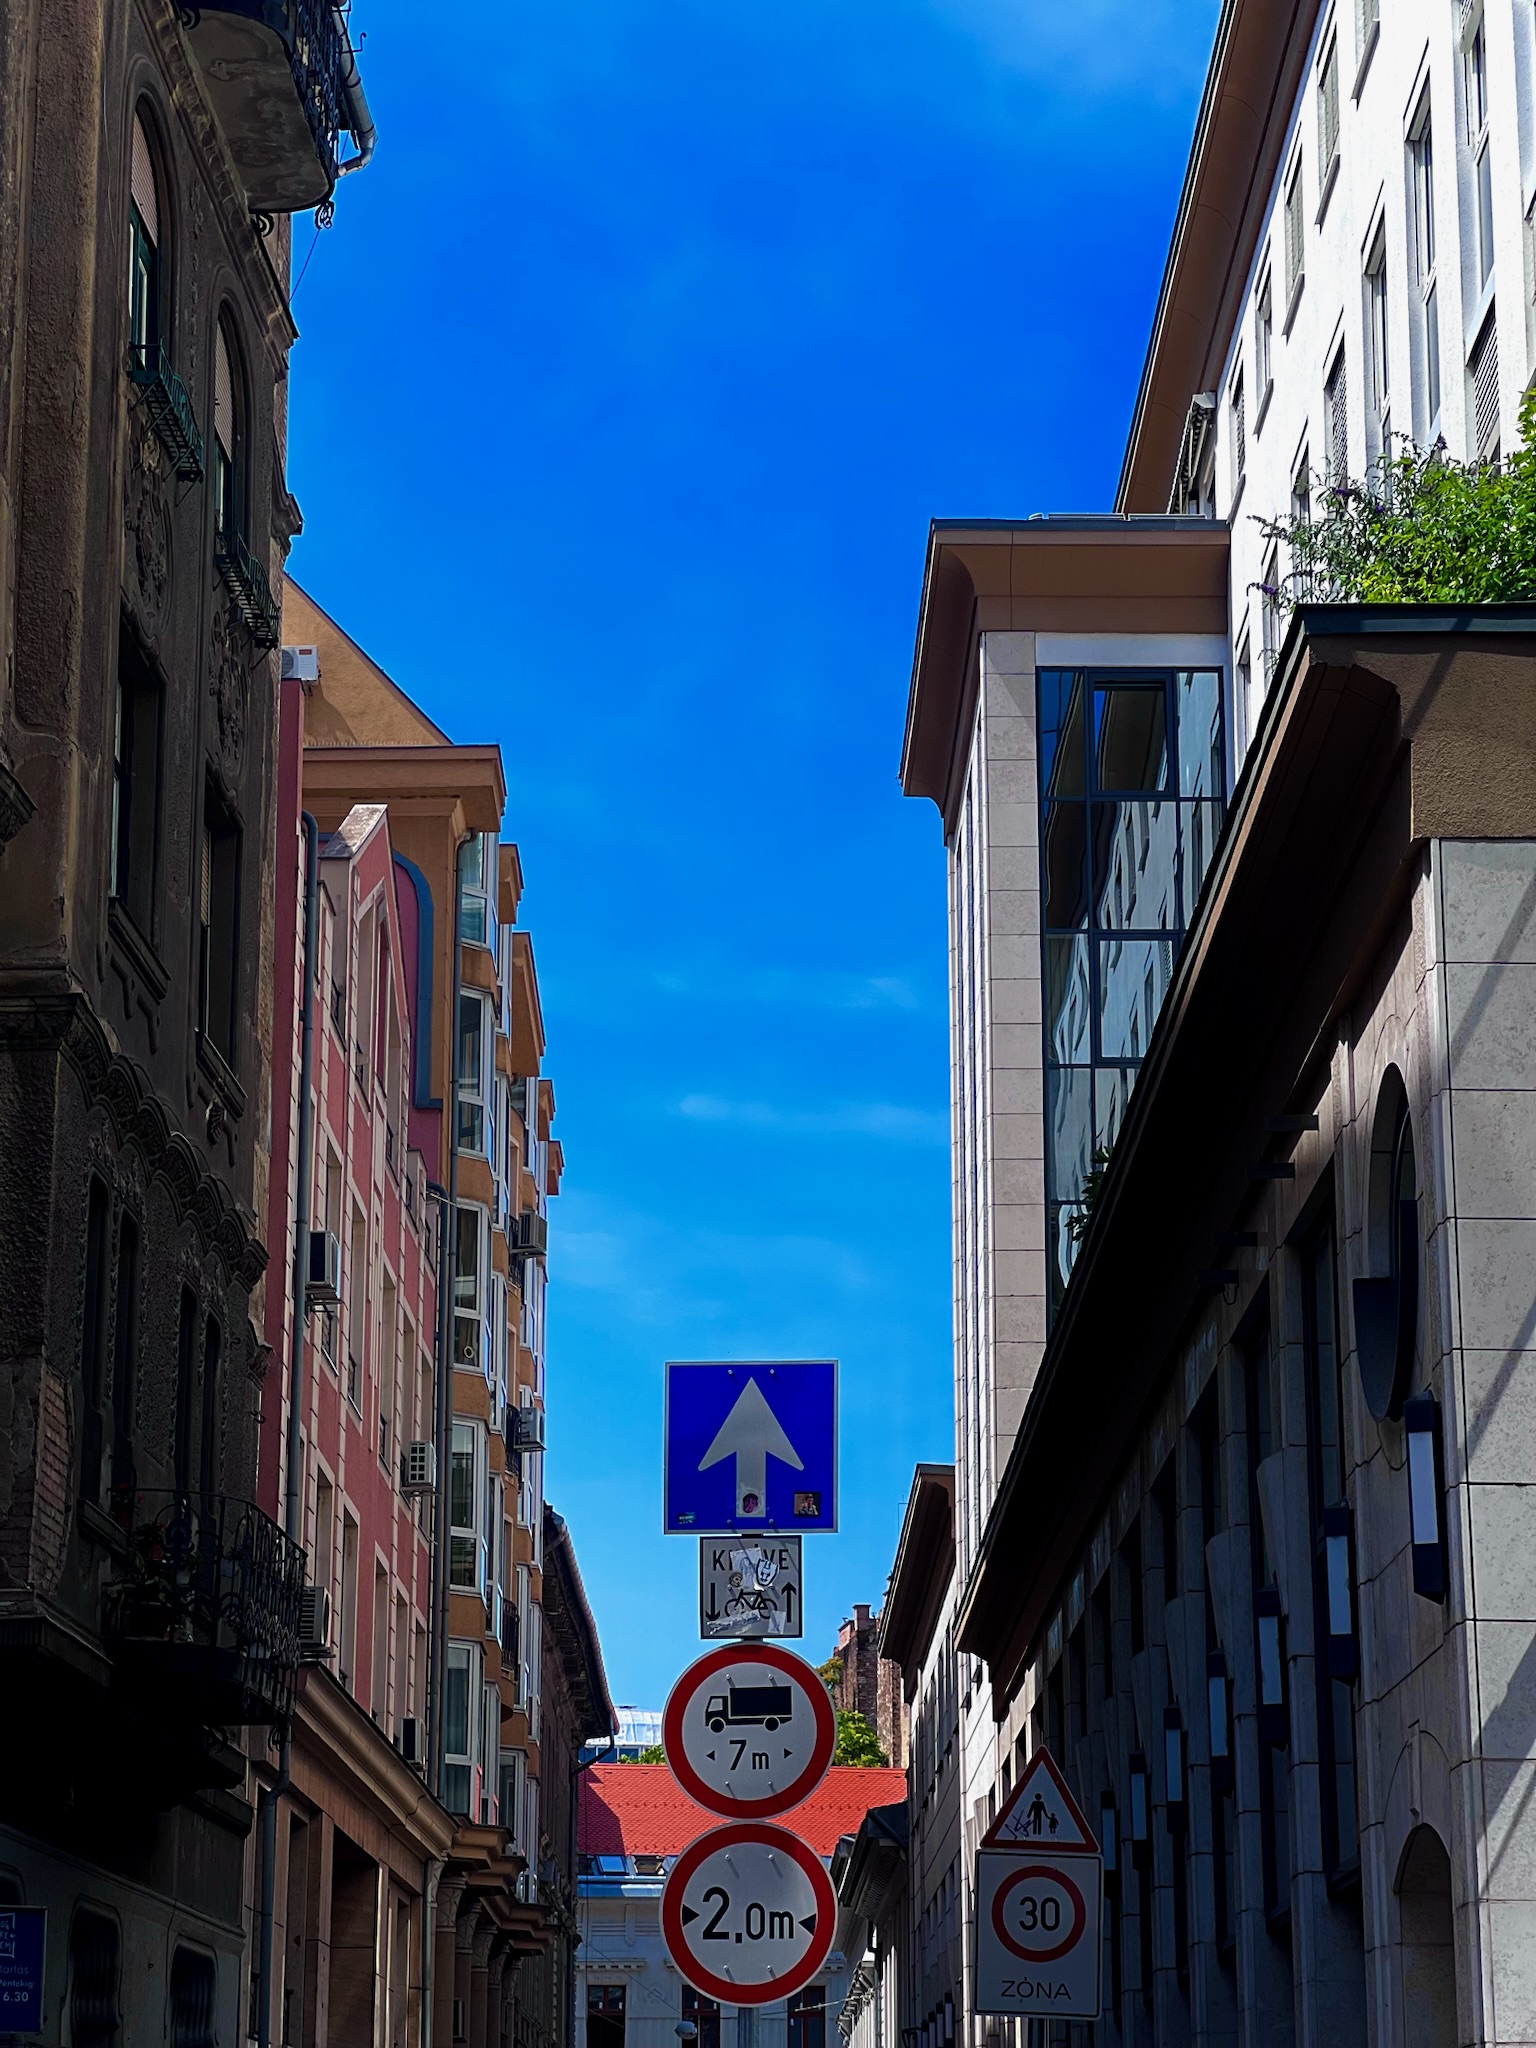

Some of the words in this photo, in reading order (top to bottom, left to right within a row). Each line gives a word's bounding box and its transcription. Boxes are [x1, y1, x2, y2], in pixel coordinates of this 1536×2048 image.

[713, 1543, 789, 1571] KIVE
[729, 1740, 747, 1770] 7
[752, 1752, 770, 1770] m
[1019, 1896, 1060, 1931] 30
[1001, 1976, 1072, 2000] ZÓNA
